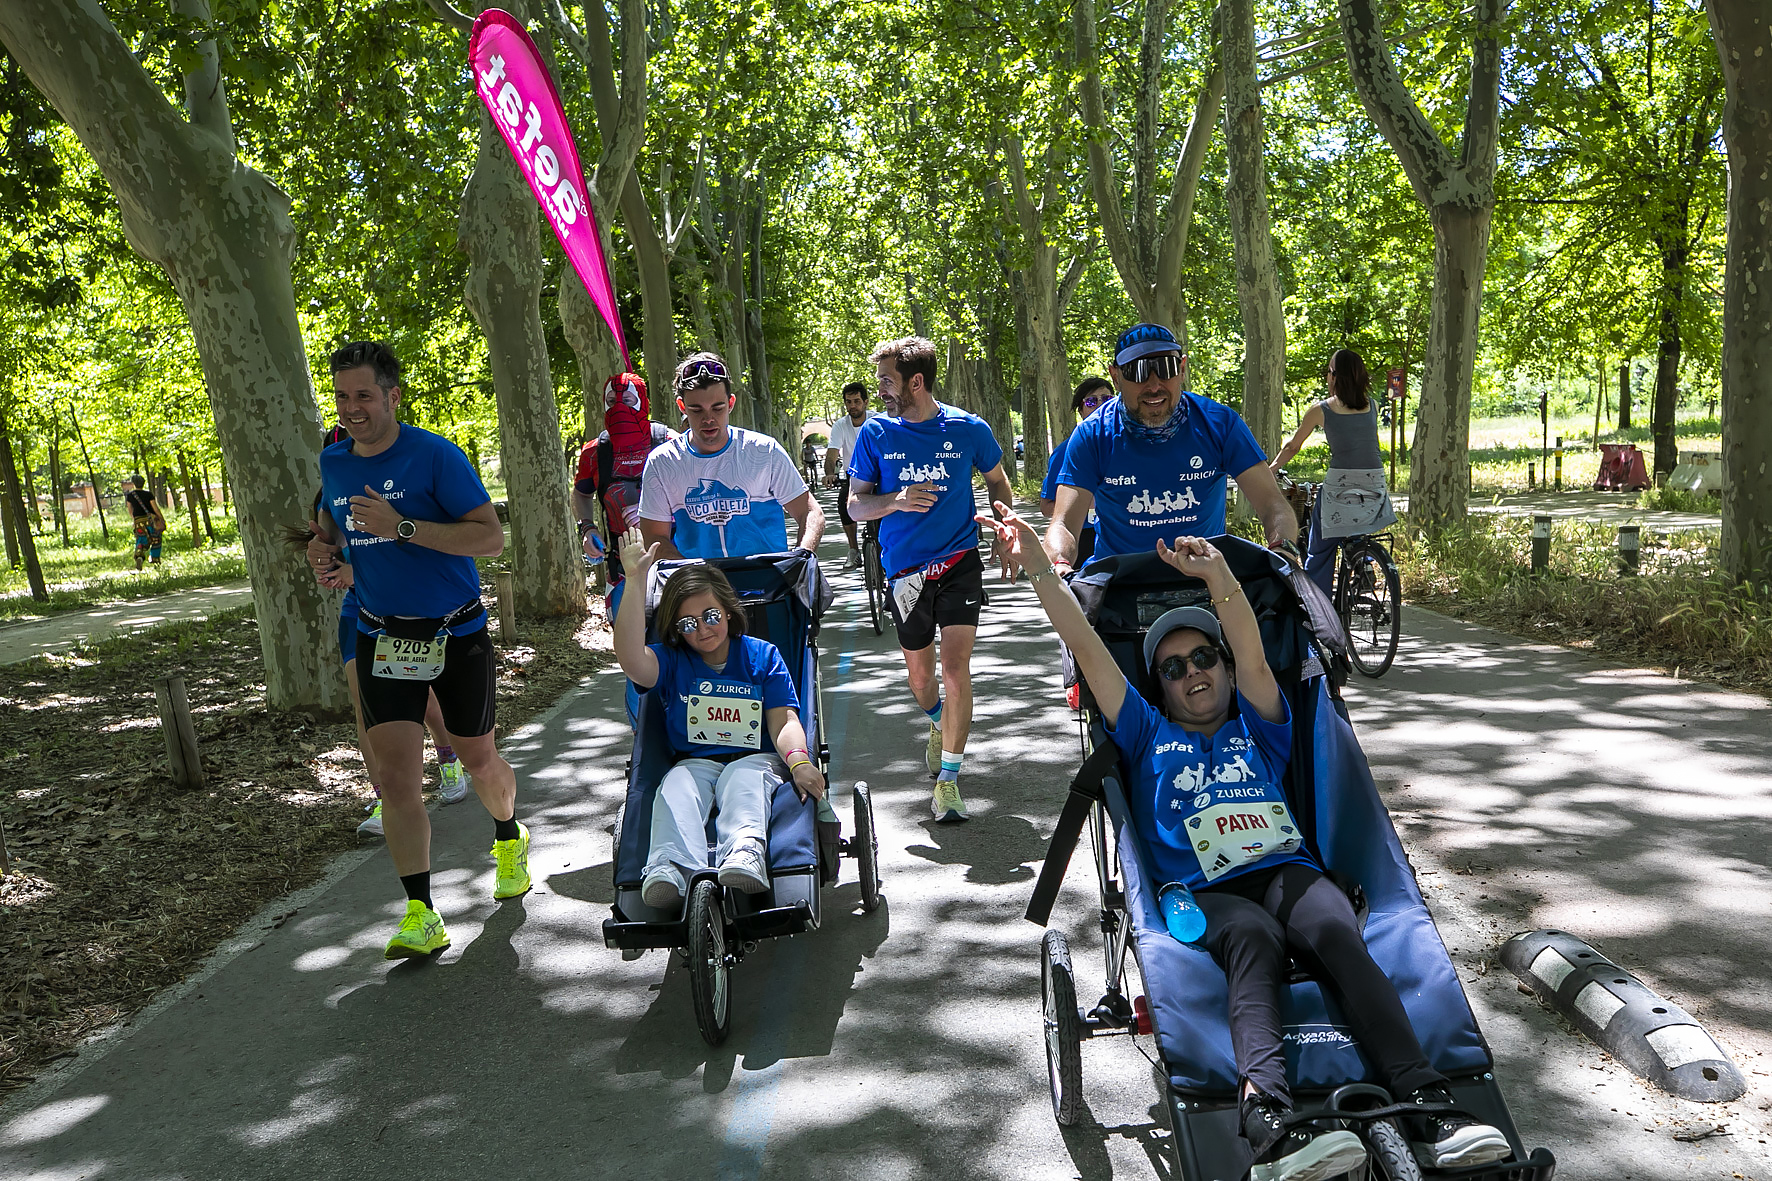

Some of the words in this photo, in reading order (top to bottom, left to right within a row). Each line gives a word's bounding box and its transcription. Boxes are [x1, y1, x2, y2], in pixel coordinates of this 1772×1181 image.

[883, 452, 906, 460] aefat
[1105, 475, 1137, 486] aefat
[1179, 470, 1216, 482] ZURICH
[379, 491, 404, 500] URICH
[686, 503, 709, 517] PICO
[712, 498, 748, 512] VELETA
[1129, 515, 1197, 527] #Imparables
[393, 639, 432, 655] 9205
[716, 684, 751, 695] ZURICH
[707, 706, 742, 723] SARA
[1155, 741, 1194, 755] aefat
[1215, 788, 1265, 799] ZURICH
[1215, 814, 1269, 835] PATRI
